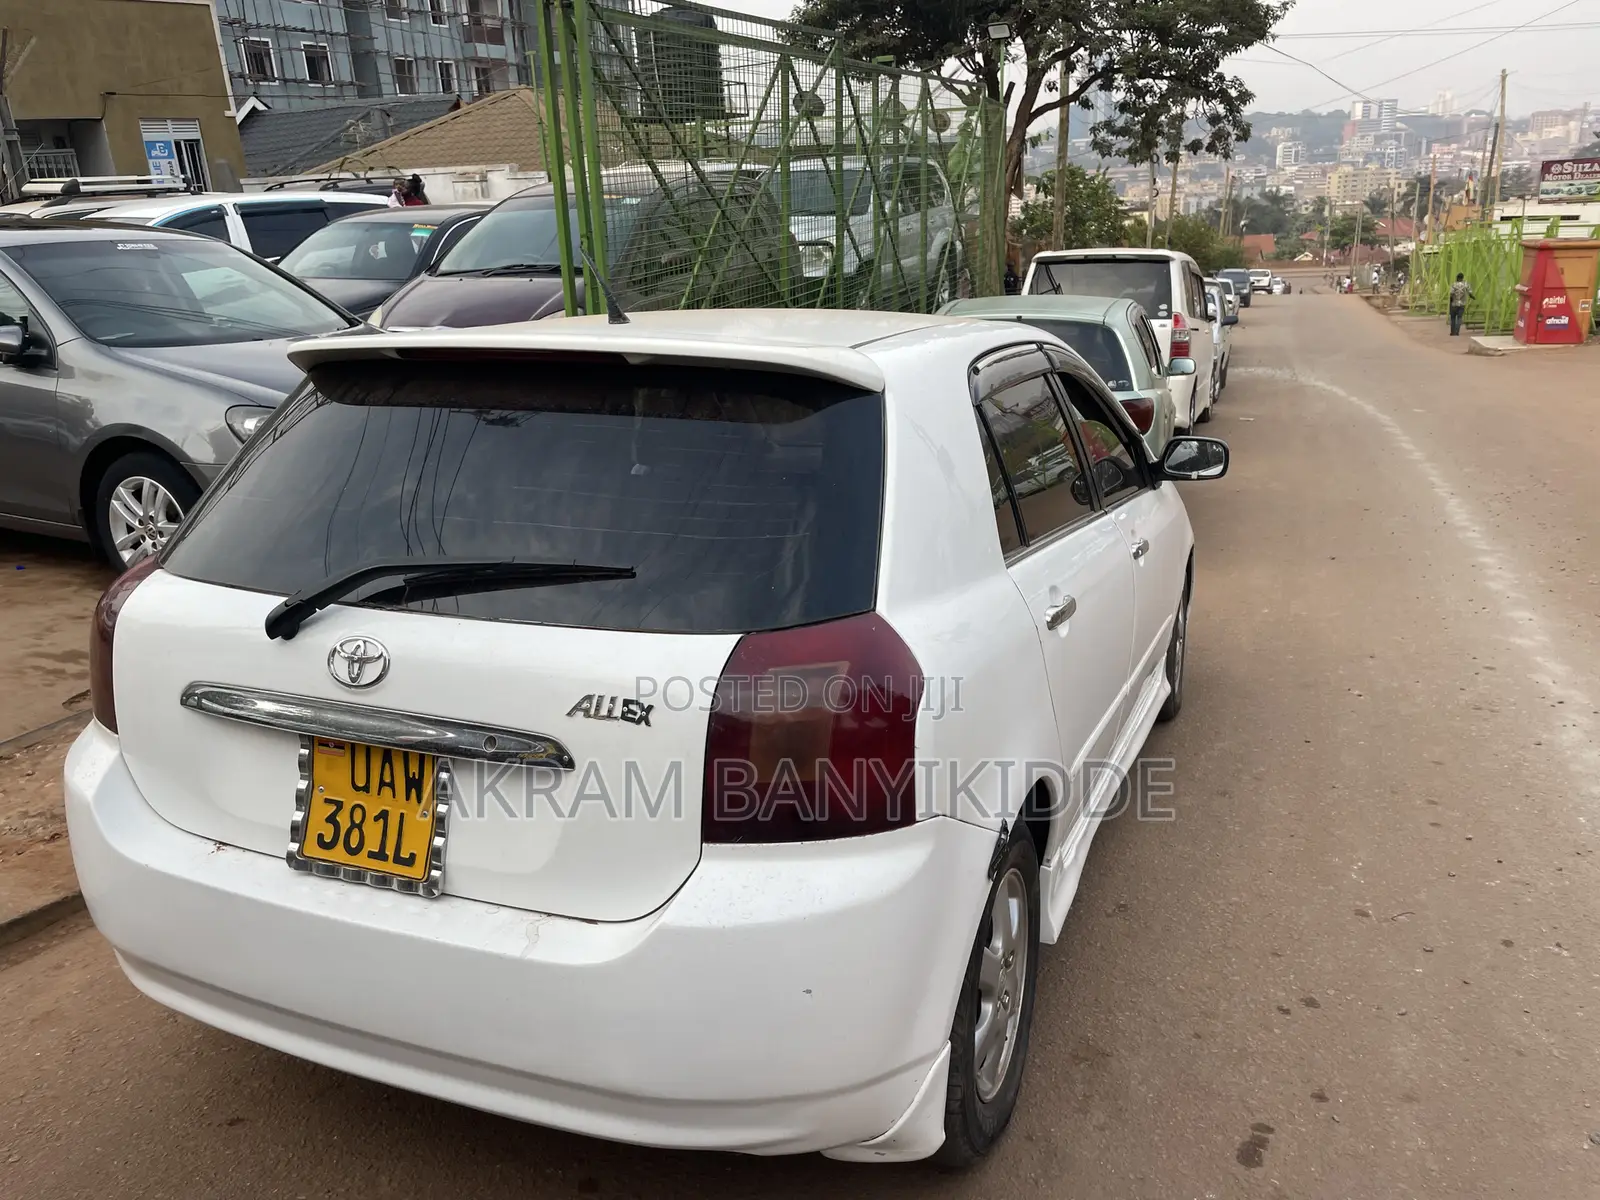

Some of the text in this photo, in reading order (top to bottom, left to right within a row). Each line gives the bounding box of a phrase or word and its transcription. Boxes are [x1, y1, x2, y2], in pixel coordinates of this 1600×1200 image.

[565, 693, 655, 727] ALLEX
[350, 742, 427, 804] UAW
[316, 797, 417, 868] 381L
